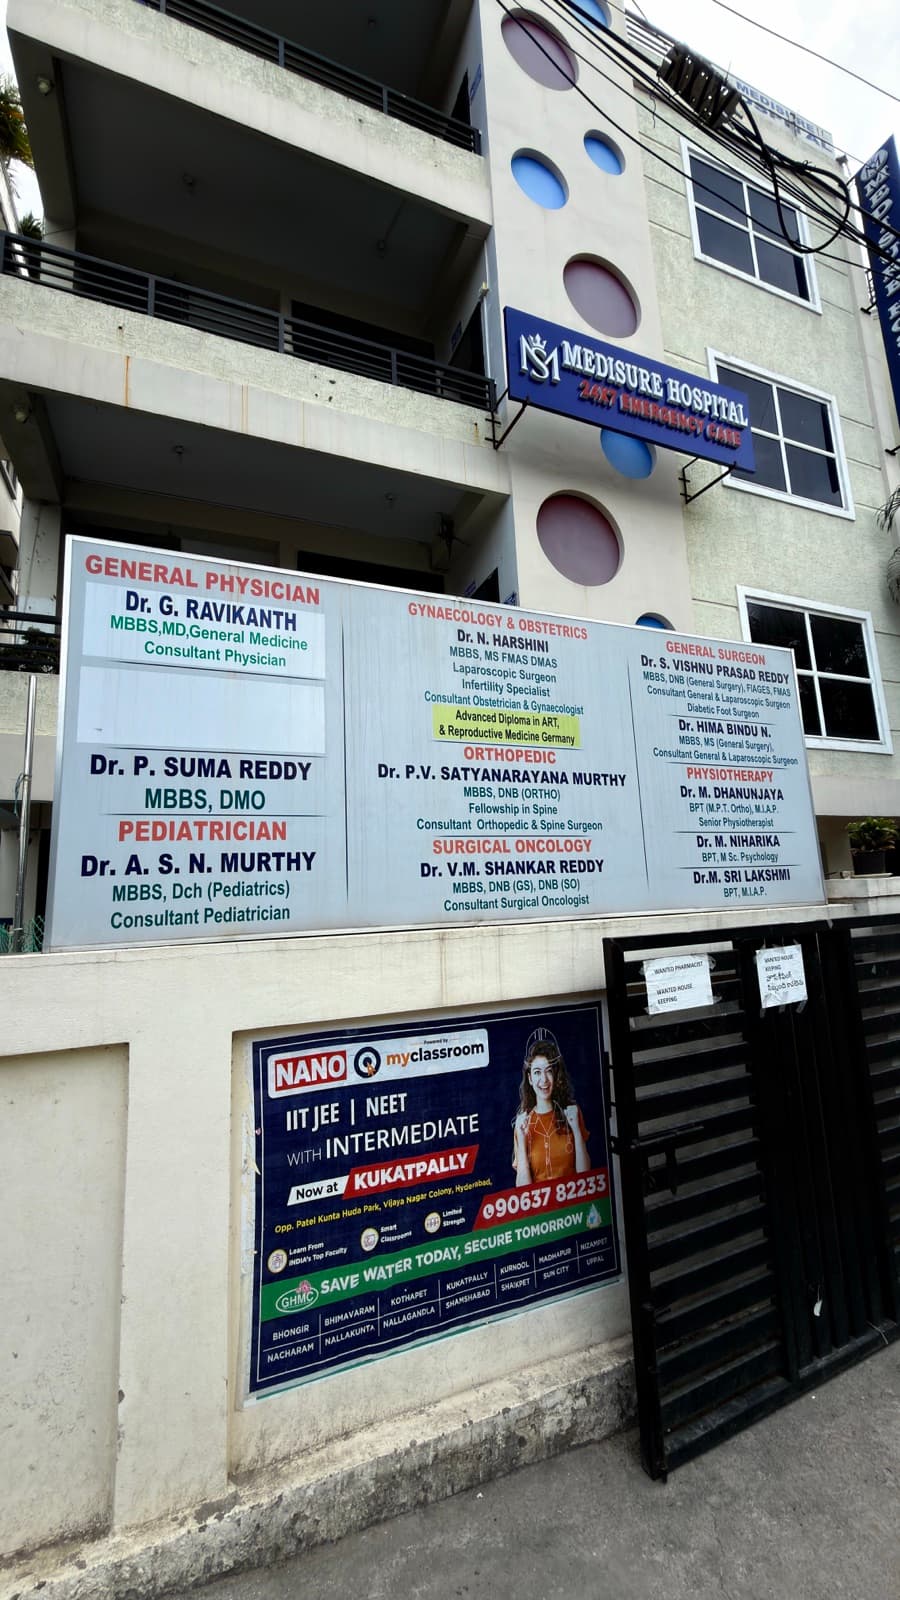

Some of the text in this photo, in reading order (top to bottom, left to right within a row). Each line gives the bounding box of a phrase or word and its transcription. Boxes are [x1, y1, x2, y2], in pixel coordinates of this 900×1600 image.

[561, 340, 748, 428] MEDISURE HOSPITAL
[619, 393, 704, 433] EMERGENCY
[707, 423, 741, 447] CARE
[85, 555, 320, 605] GENERAL PHYSICIAN
[125, 590, 297, 631] Dr. G. RAVIKANTH
[408, 602, 588, 639] GYNAECOLOGY & OBSTETRICS
[249, 632, 307, 650] Medicine
[458, 629, 549, 652] Dr. N. HARSHINI
[144, 641, 286, 666] Consultant Physician
[666, 641, 765, 665] GENERAL SURGEON
[641, 655, 789, 684] Dr. S. VISHNU PRASAD REDDY
[462, 679, 550, 697] Infertility Specialist
[456, 710, 496, 723] Advanced
[499, 714, 530, 727] Diploma
[533, 716, 539, 725] in
[439, 725, 575, 746] & Reproductive Medicine Germany
[679, 720, 771, 737] Dr. HIMA BINDU N.
[464, 747, 556, 764] ORTHOPEDIC
[653, 748, 692, 759] Consultant
[694, 750, 720, 760] General
[728, 754, 771, 763] Laparoscopic
[773, 755, 798, 766] Surgeon
[91, 754, 312, 780] Dr. P. SUMA REDDY
[378, 764, 626, 786] Dr. P.V. SATYANARAYANA MURTHY
[687, 767, 773, 783] PHYSIOTHERAPY
[145, 788, 265, 812] MBBS, DMO
[681, 786, 784, 800] Dr. M. DHANUNJAYA
[469, 803, 558, 816] Fellowship in Spine
[118, 821, 287, 841] PEDIATRICIAN
[417, 819, 602, 832] Consultant Orthopedic & Spine Surgeon
[699, 817, 773, 828] Senior Physiotherapist
[433, 840, 592, 854] SURGICAL ONCOLOGY
[697, 835, 780, 847] Dr. M. NIHARIKA
[81, 852, 316, 876] Dr. A. S. N. MURTHY
[421, 860, 603, 877] Dr. V.M. SHANKAR REDDY
[724, 870, 741, 882] SRI
[745, 869, 790, 881] LAKSHMI
[112, 880, 290, 902] MBBS, Dch (Pediatrics)
[111, 906, 290, 928] Consultant Pediatrician
[654, 961, 703, 975] WANTED PHARMACIST
[657, 986, 676, 995] WANTED
[276, 1043, 484, 1087] NANO myclassroom
[287, 1093, 407, 1131] IIT JEE NEET
[287, 1114, 479, 1166] WITH INTERMEDIATE
[296, 1153, 468, 1199] Now at KUKATPALLY
[496, 1174, 606, 1217] 90637 82233
[275, 1224, 294, 1233] Opp.
[296, 1219, 316, 1228] Patel
[318, 1213, 340, 1224] Kunta
[342, 1208, 361, 1218] Huda
[364, 1204, 381, 1212] Park,
[383, 1199, 405, 1208] Vijaya
[406, 1193, 427, 1204] Nagar
[429, 1186, 454, 1199] Colony,
[443, 1208, 462, 1217] Limited
[381, 1224, 396, 1232] Smart
[443, 1217, 465, 1227] Strength
[308, 1242, 324, 1250] From
[313, 1253, 324, 1261] Top
[325, 1248, 347, 1257] Faculty
[321, 1212, 583, 1294] SAVE WATER TODAY, SECURE TOMORROW
[539, 1248, 571, 1263] MADHAPUR
[587, 1256, 604, 1266] UPPAL
[501, 1261, 529, 1275] KURNOOL
[543, 1266, 569, 1279] SUN CITY
[446, 1272, 488, 1291] KUKATPALLY
[501, 1278, 530, 1291] SHAIKPET
[282, 1292, 313, 1308] GHMC
[391, 1289, 428, 1306] KOTHAPET
[446, 1289, 490, 1309] SHAMSHABAD
[325, 1305, 375, 1326] BHIMAVARAM
[384, 1306, 435, 1328] NALLAGANDLA
[273, 1325, 309, 1341] BHONGIR
[325, 1324, 375, 1345] NALLAKUNTA
[268, 1343, 314, 1363] NACHARAM
